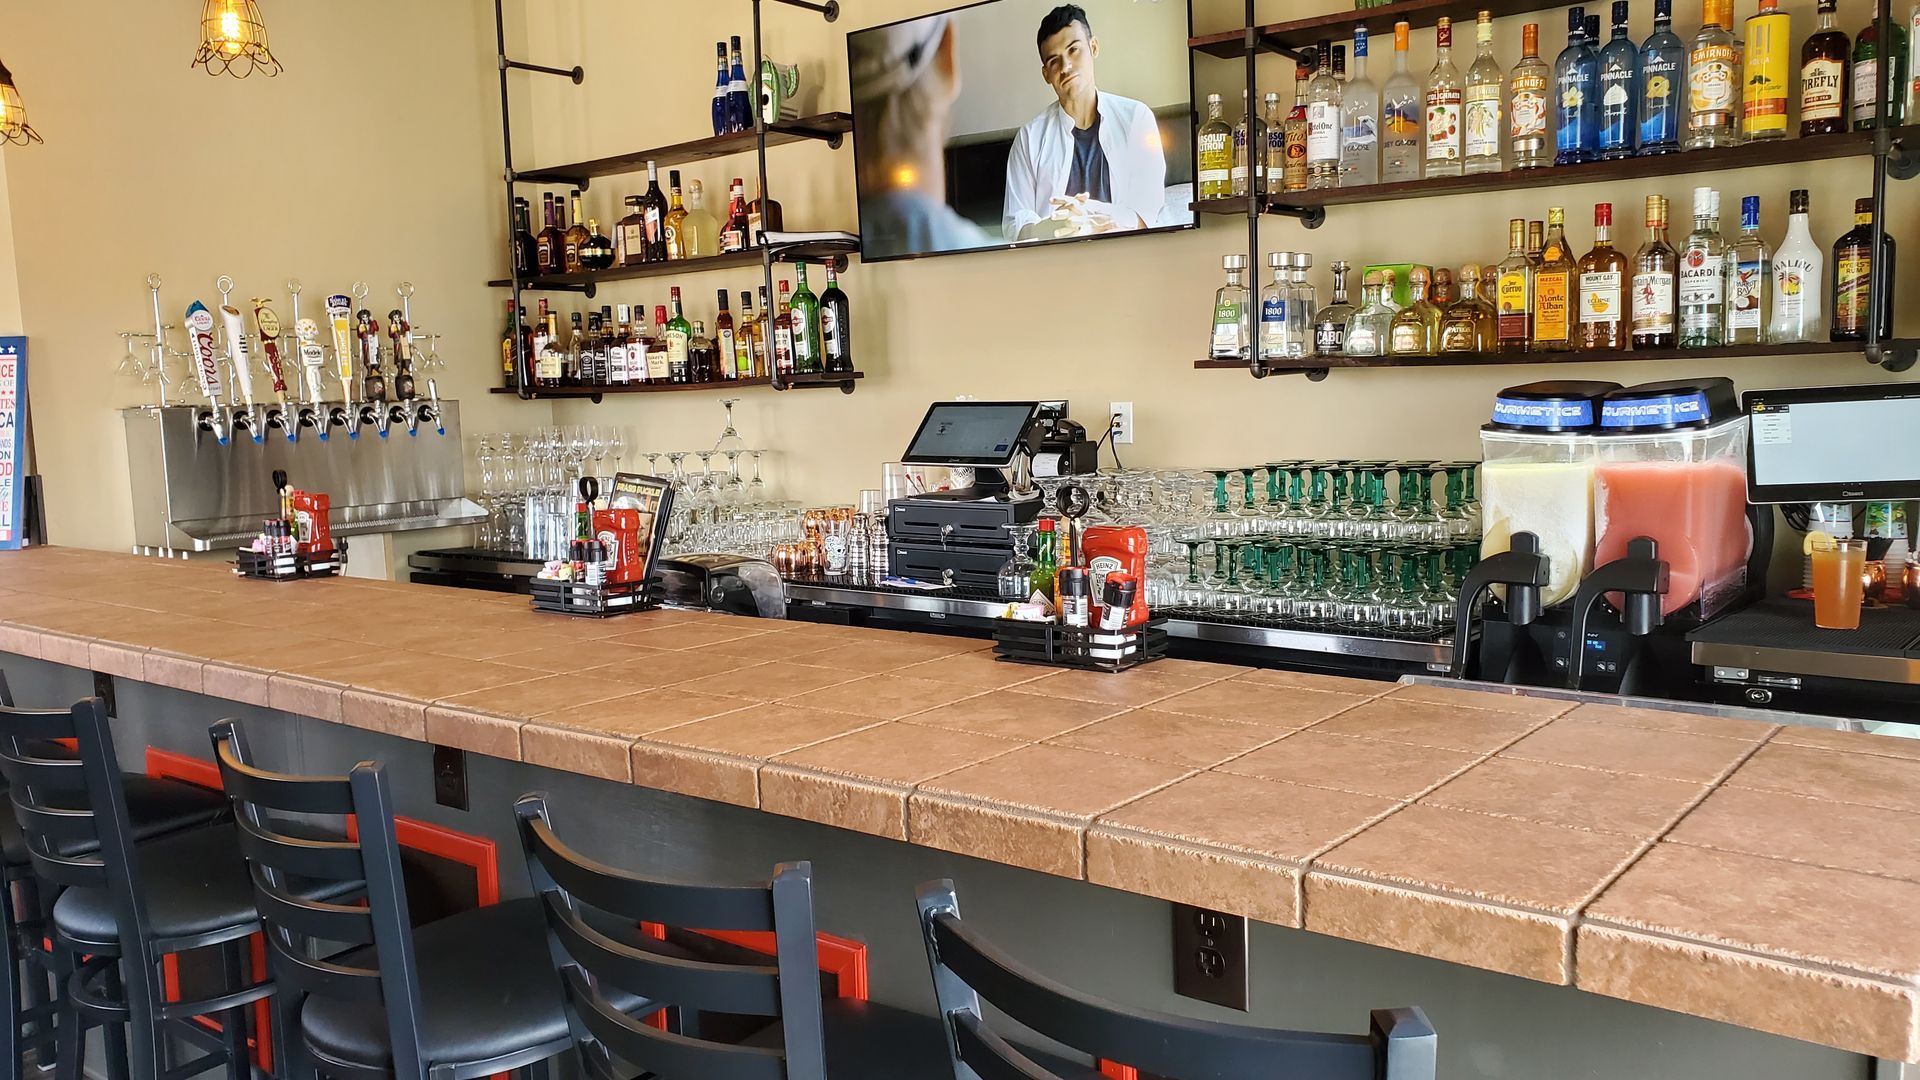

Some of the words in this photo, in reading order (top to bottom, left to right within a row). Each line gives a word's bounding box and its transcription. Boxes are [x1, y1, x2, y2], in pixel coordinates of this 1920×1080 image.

[1643, 62, 1676, 75] PINNACLE
[1557, 74, 1589, 85] PINNACLE
[1600, 70, 1633, 82] PINNACLE
[1802, 75, 1839, 95] FIREFLY
[1774, 258, 1814, 273] MALIBU
[1603, 274, 1614, 282] GAY
[1681, 266, 1715, 279] BACARDÍ
[1737, 287, 1752, 297] BAY
[1539, 294, 1564, 303] Monte
[1265, 306, 1282, 316] 1800
[1539, 302, 1564, 310] Alban
[1218, 309, 1236, 318] 1800
[1316, 330, 1344, 345] CABO
[197, 332, 219, 385] Coors
[1557, 405, 1583, 418] ICE
[1673, 400, 1700, 414] ICE
[1095, 562, 1114, 571] HEINZ
[1095, 572, 1107, 580] TOM
